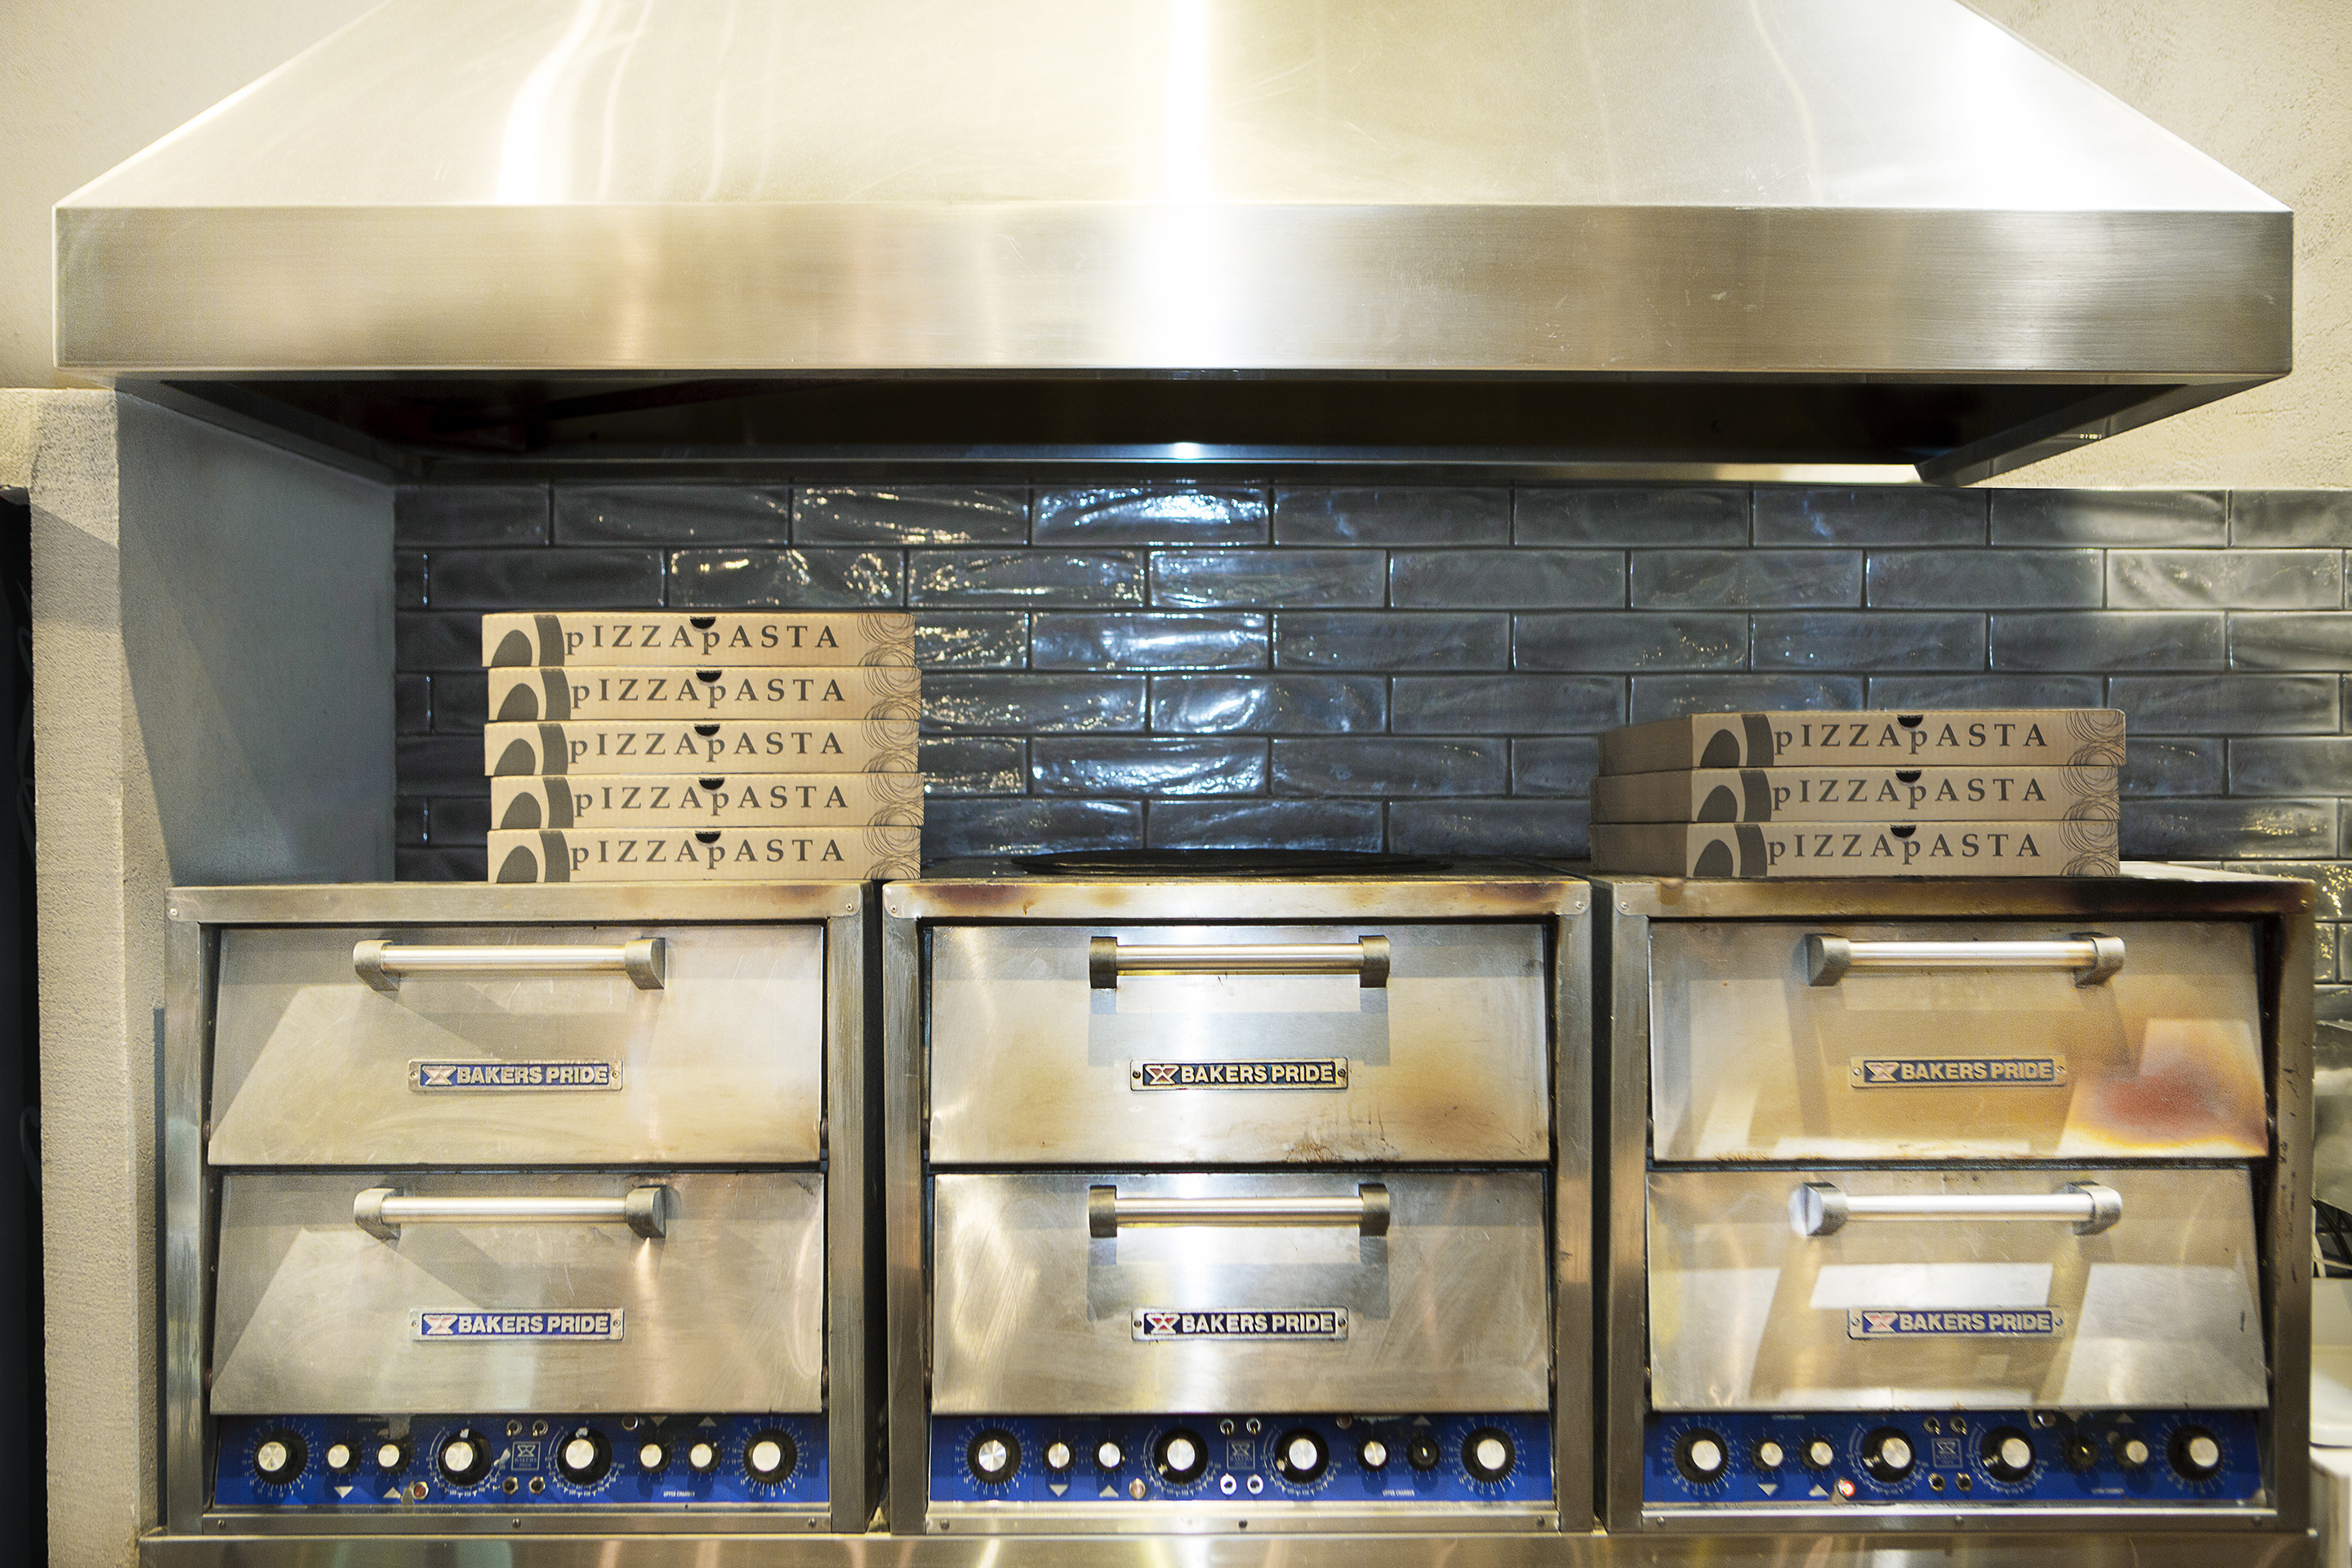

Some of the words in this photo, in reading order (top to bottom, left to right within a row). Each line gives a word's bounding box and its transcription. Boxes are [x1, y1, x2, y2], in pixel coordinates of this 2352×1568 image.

[457, 1067, 541, 1085] BAKERS
[546, 1067, 608, 1084] PRIDE
[1181, 1065, 1267, 1084] BAKERS
[1272, 1064, 1334, 1083] PRIDE
[1900, 1062, 1987, 1081] BAKERS
[1990, 1062, 2052, 1080] PRIDE
[457, 1316, 543, 1334] BAKERS
[547, 1316, 608, 1333] PRIDE
[1182, 1314, 1268, 1333] BAKERS
[1272, 1313, 1334, 1332] PRIDE
[1899, 1312, 1986, 1331] BAKERS
[1989, 1312, 2051, 1331] PRIDE
